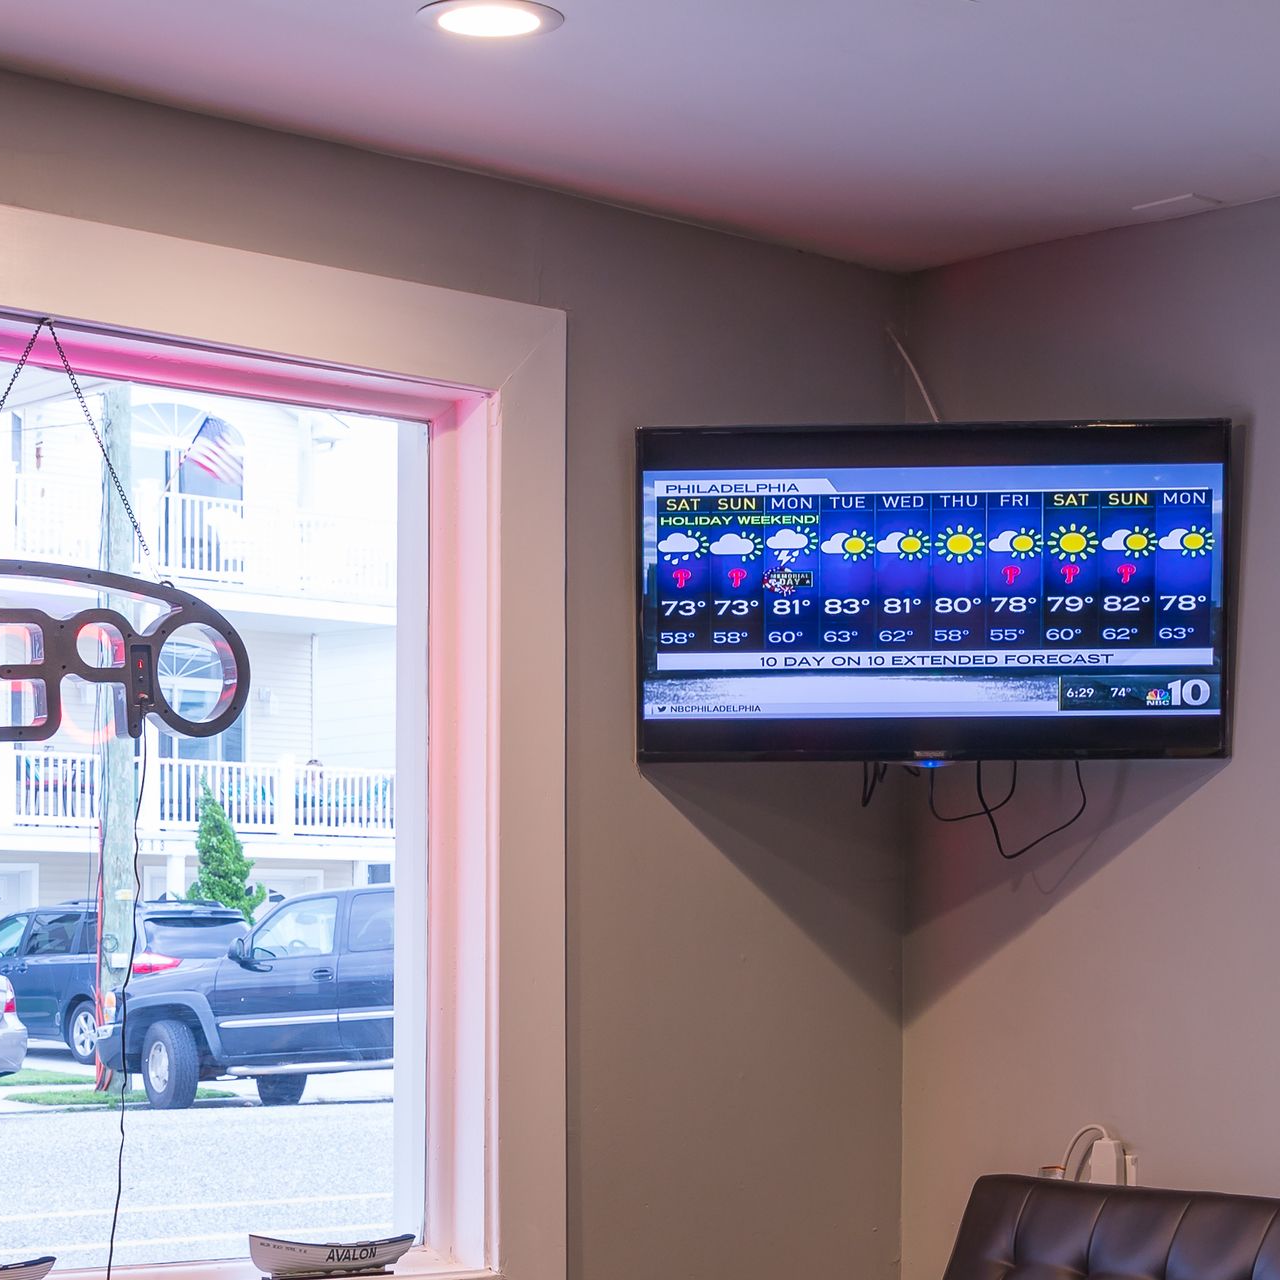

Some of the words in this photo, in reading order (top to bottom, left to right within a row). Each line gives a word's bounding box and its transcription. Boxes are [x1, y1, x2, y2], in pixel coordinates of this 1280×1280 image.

[665, 483, 799, 494] PHILADELPHIA
[666, 498, 701, 511] SAT
[717, 497, 756, 510] SUN
[771, 497, 813, 510] MON
[829, 496, 866, 509] TUE
[882, 495, 924, 508] WED
[940, 495, 978, 507] THU
[1000, 494, 1029, 507] FRI
[1053, 493, 1089, 506] SAT
[1108, 492, 1148, 505] SUN
[1163, 491, 1206, 505] MON
[660, 516, 733, 526] HOLIDAY
[737, 514, 819, 525] WEEKEND!
[780, 578, 800, 586] DAY
[760, 657, 777, 667] 10
[784, 656, 826, 667] DAY
[831, 656, 861, 667] ON
[868, 655, 885, 666] 10
[891, 654, 998, 666] EXTENDED
[1004, 653, 1114, 665] FORECAST
[1066, 688, 1095, 698] 6:29
[1167, 679, 1211, 706] 10
[670, 704, 761, 713] NBCPHILADELPHIA
[325, 1246, 377, 1263] AVALON
